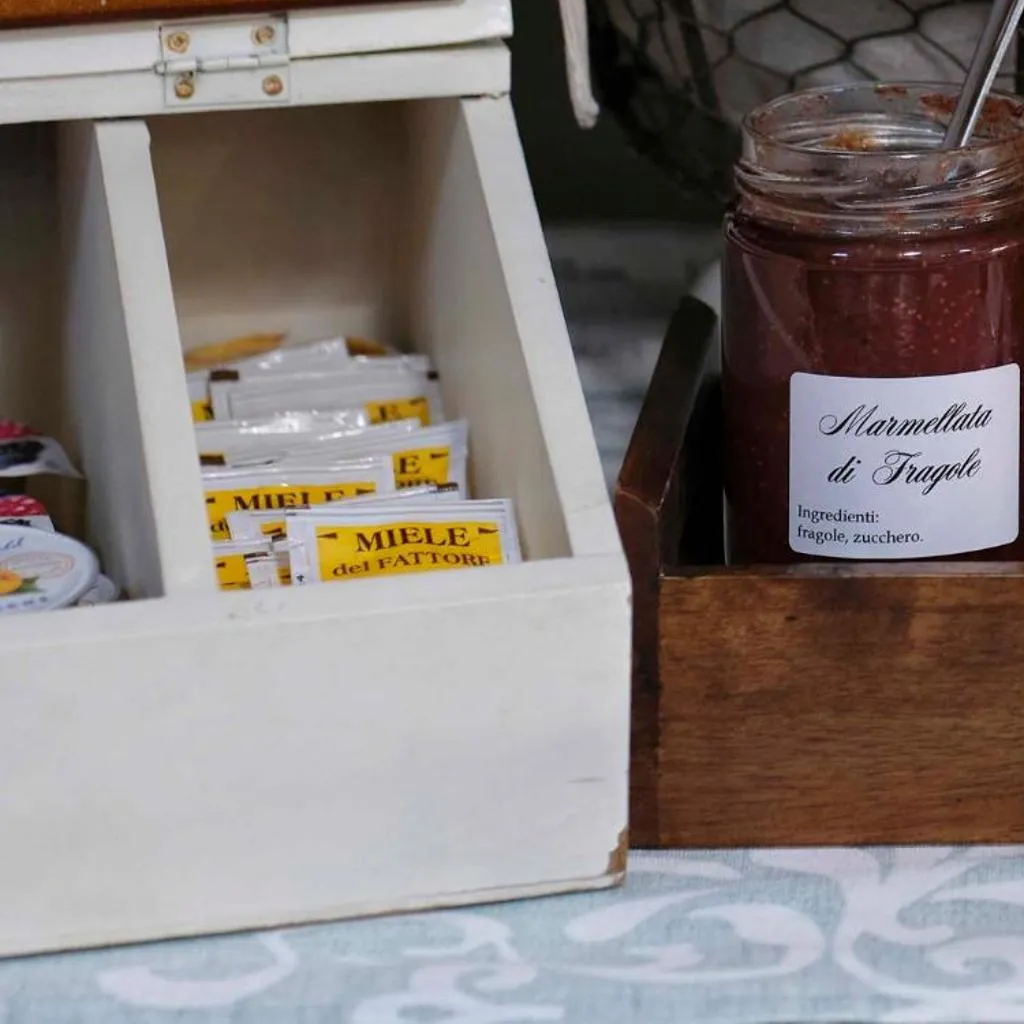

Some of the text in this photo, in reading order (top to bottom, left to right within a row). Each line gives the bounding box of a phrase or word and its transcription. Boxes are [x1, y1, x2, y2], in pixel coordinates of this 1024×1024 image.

[819, 402, 992, 437] Marmellata
[827, 448, 982, 496] di Fragole
[797, 505, 879, 524] Ingredienti:
[355, 527, 471, 552] MIELE
[797, 525, 924, 545] fragole, zucchero.
[333, 562, 369, 577] del
